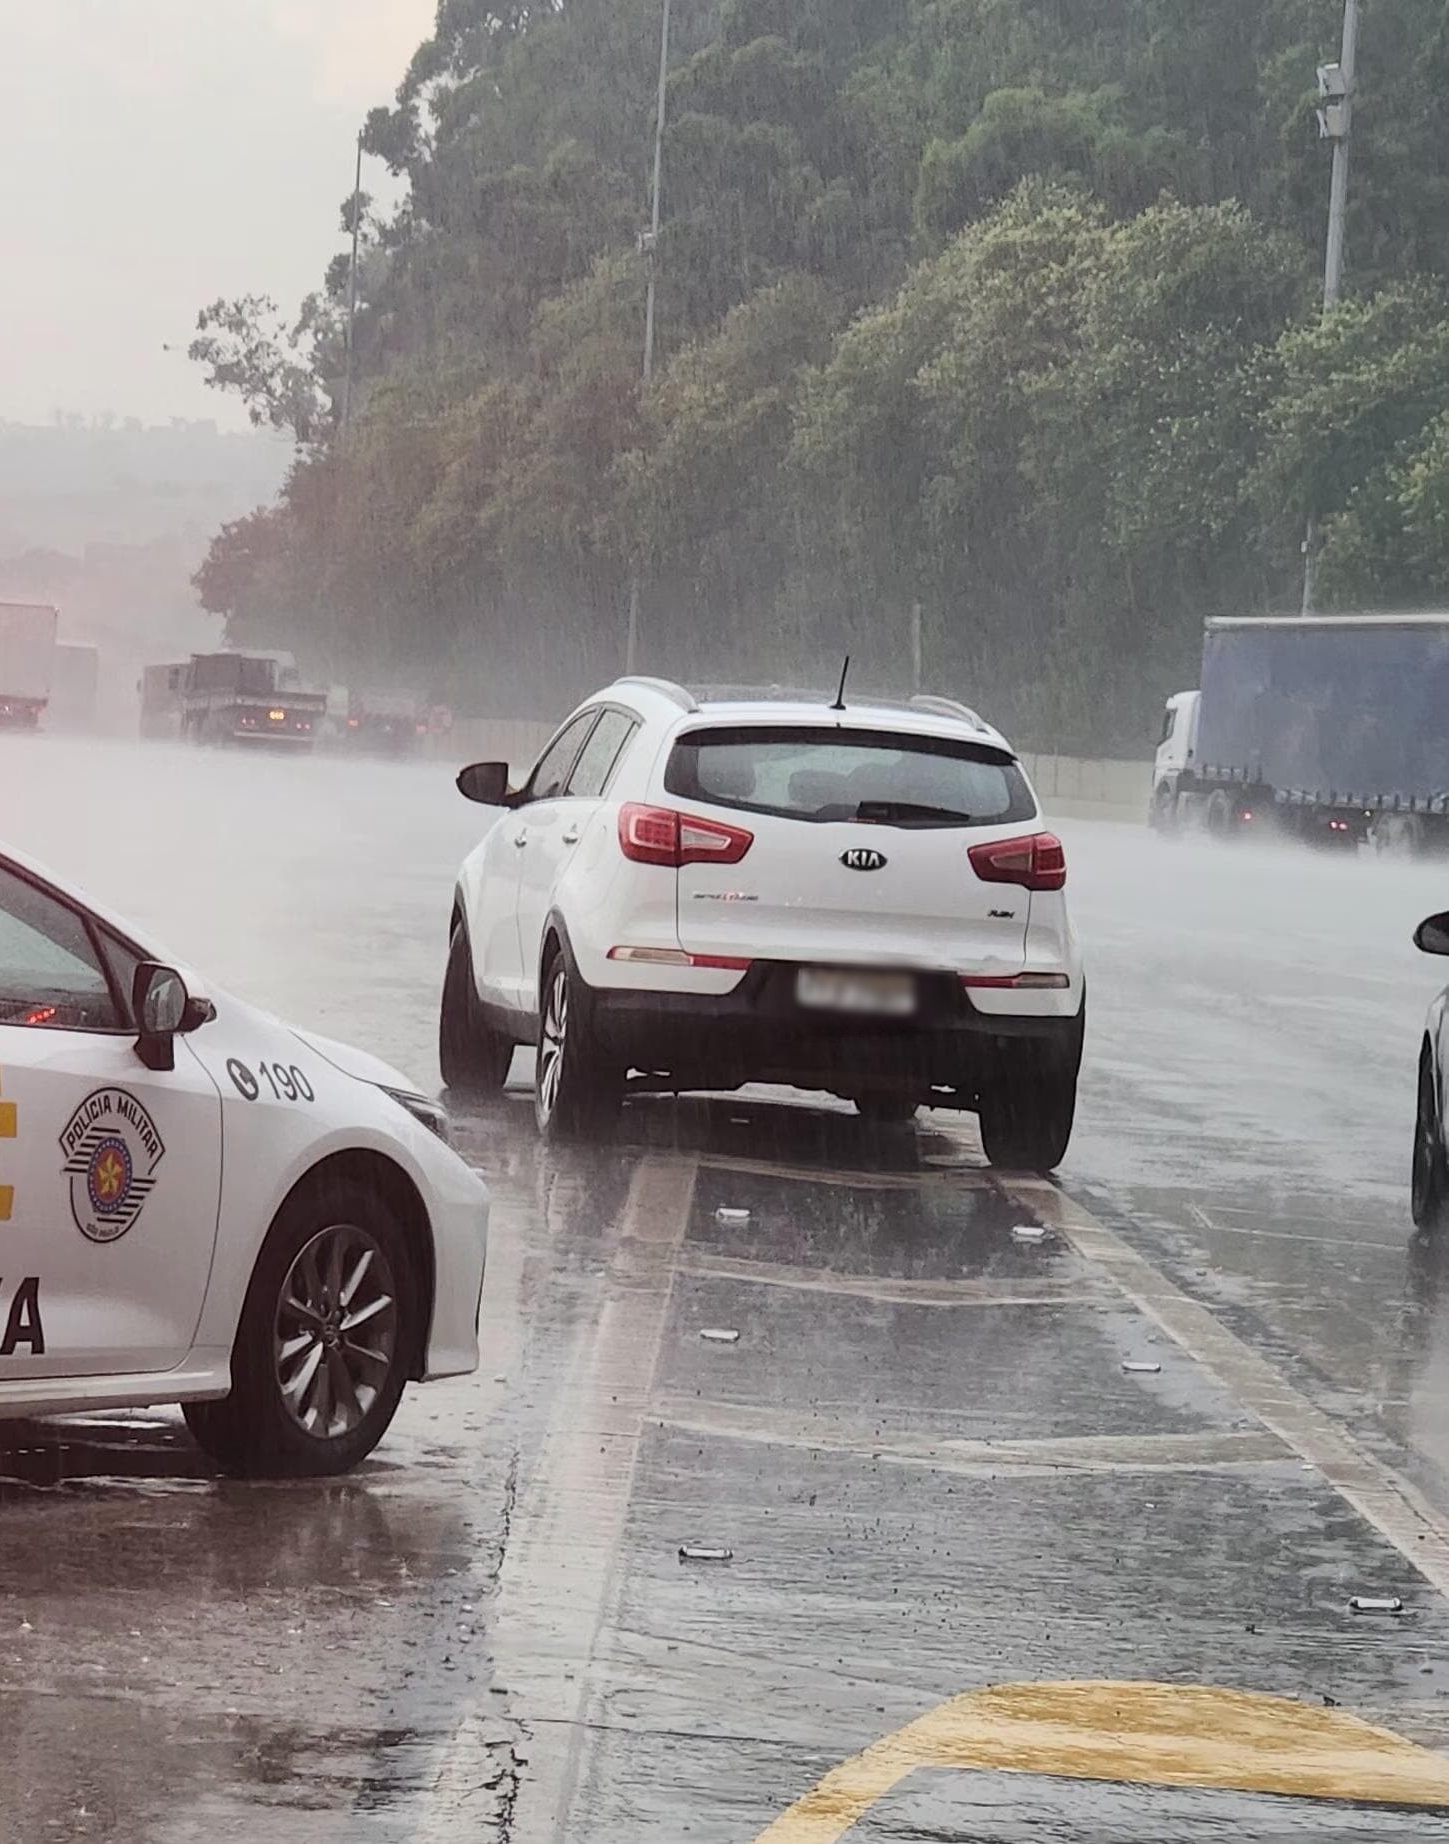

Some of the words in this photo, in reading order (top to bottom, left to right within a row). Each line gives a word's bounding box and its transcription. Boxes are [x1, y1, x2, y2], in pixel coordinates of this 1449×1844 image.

[847, 850, 880, 867] KIA
[259, 1061, 315, 1102] 190
[117, 1095, 159, 1159] MILITAR
